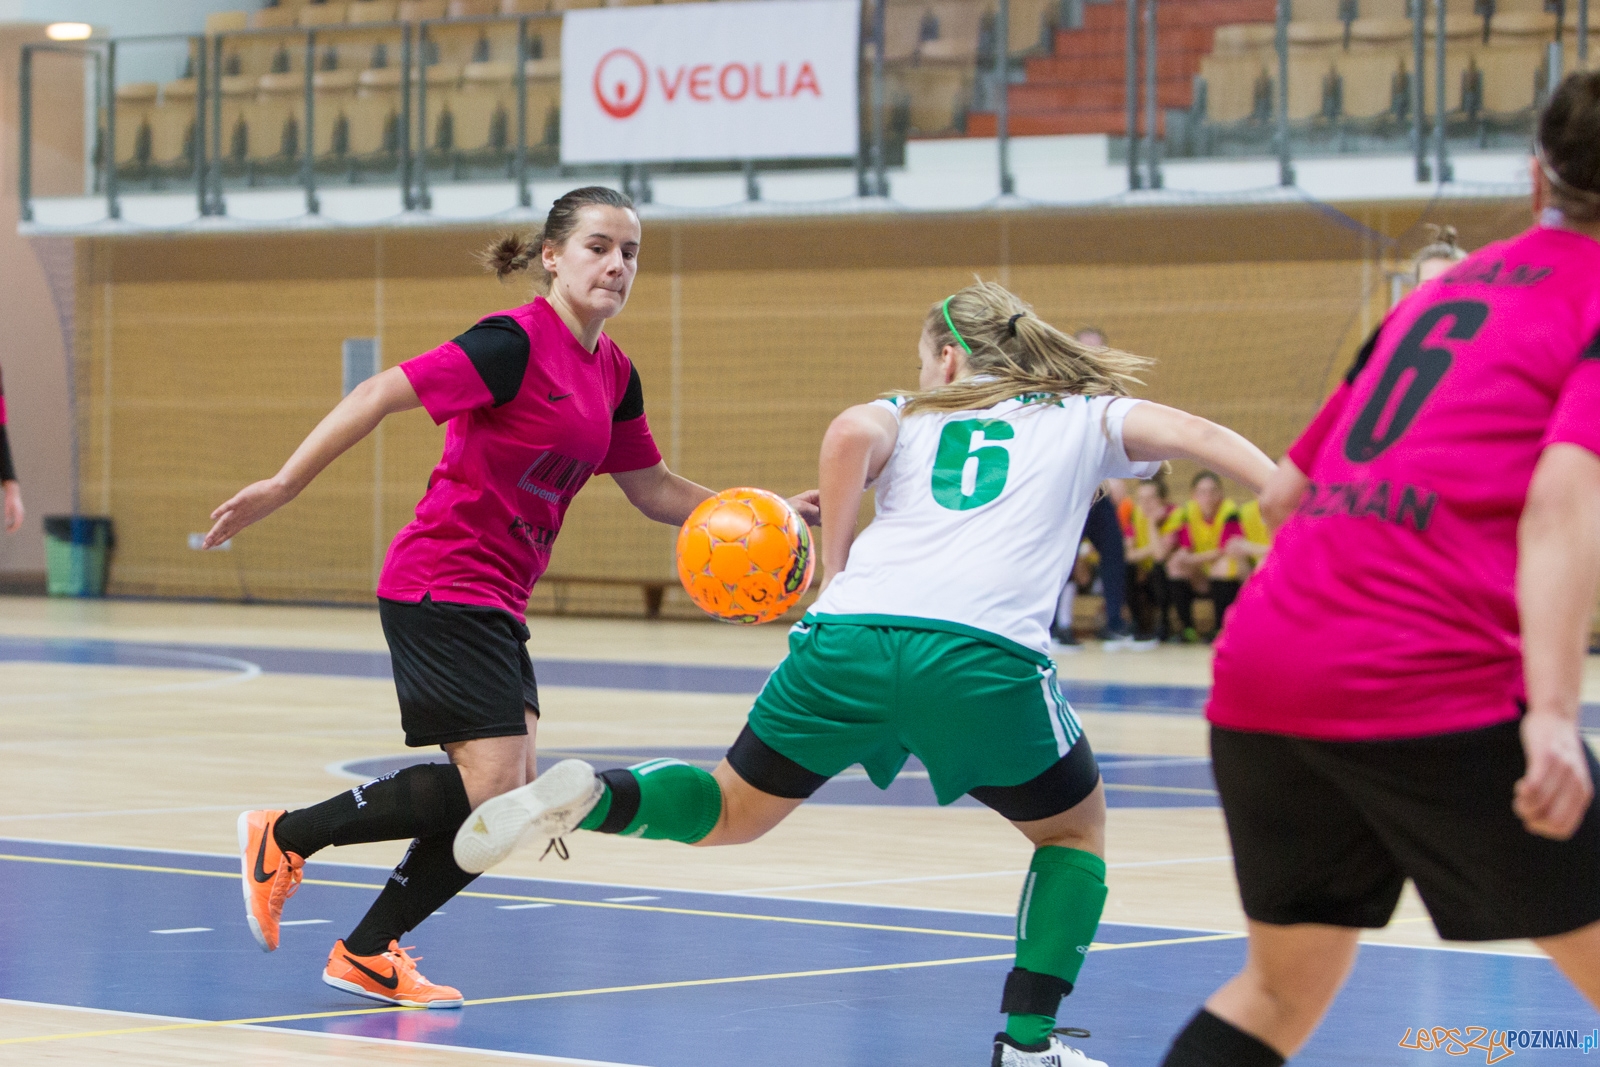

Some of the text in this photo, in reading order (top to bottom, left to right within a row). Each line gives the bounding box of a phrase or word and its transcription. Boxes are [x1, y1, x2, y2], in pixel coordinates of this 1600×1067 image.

[657, 62, 821, 103] VEOLIA
[1345, 300, 1489, 463] 6
[931, 418, 1015, 511] 6
